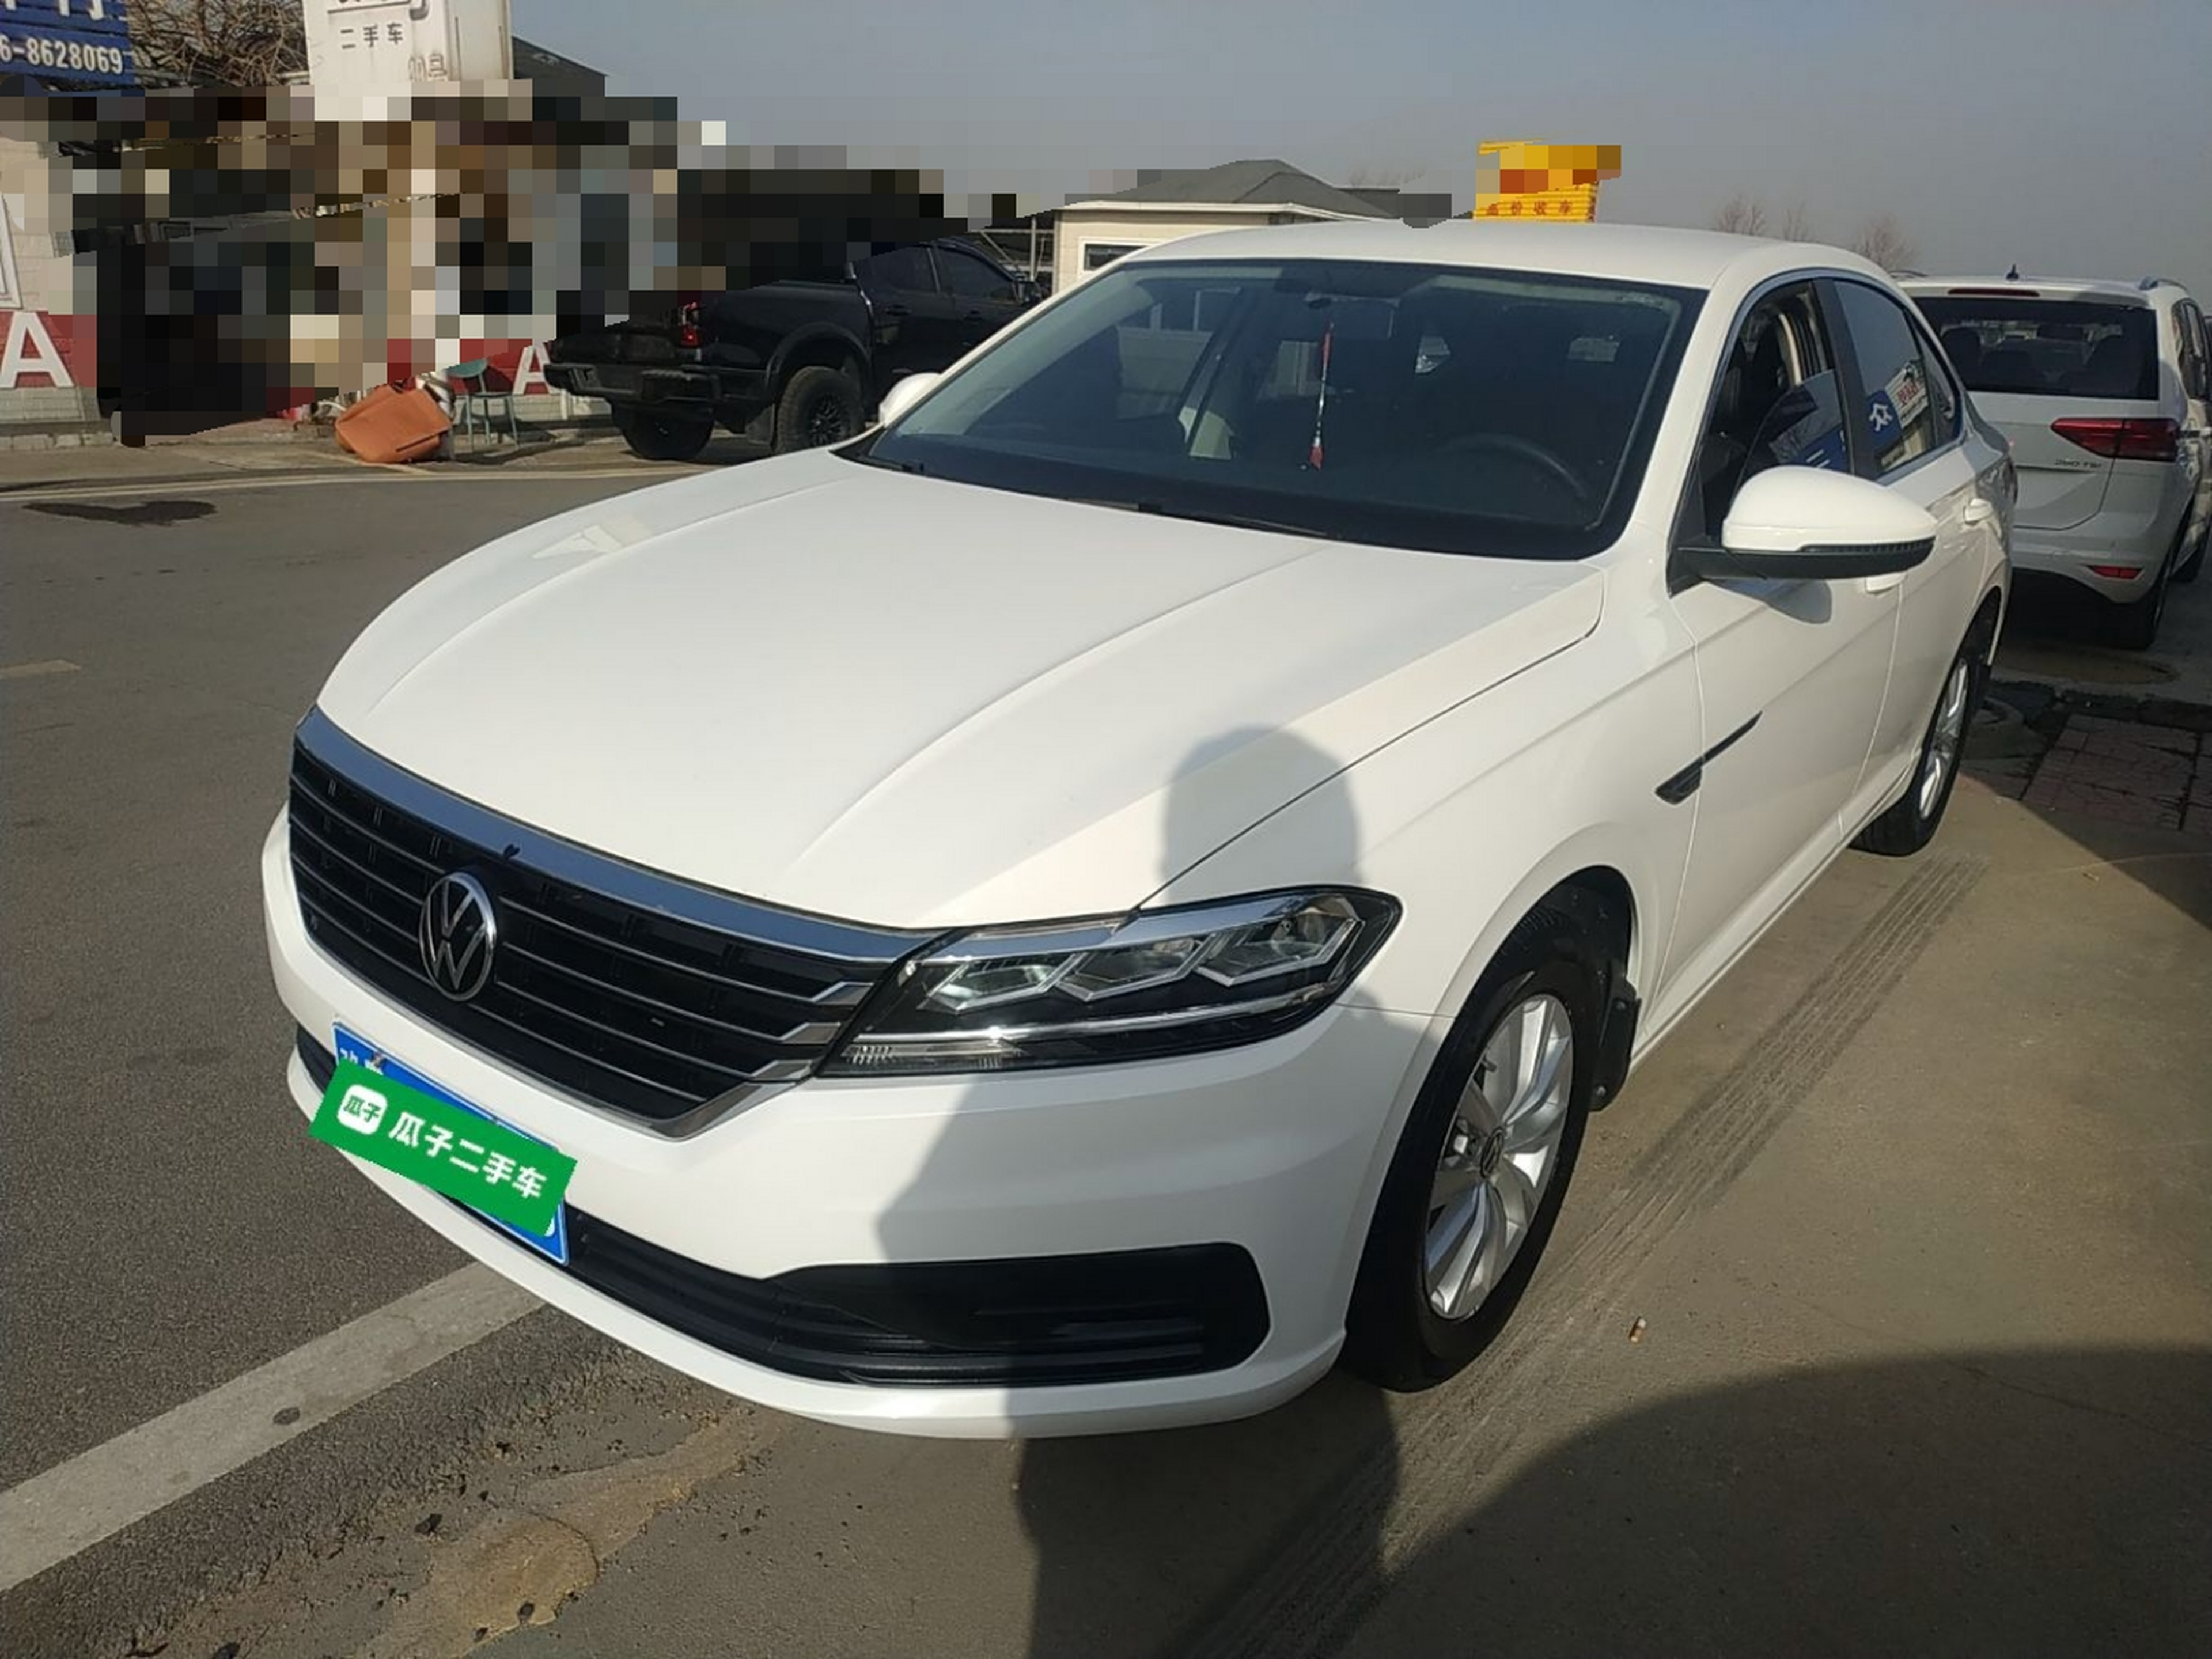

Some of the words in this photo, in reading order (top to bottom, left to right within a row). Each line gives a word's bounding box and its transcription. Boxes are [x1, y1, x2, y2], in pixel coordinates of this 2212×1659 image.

[0, 33, 123, 75] 6-8628069
[340, 22, 403, 48] 二手车
[0, 311, 74, 388] A
[512, 342, 562, 395] A
